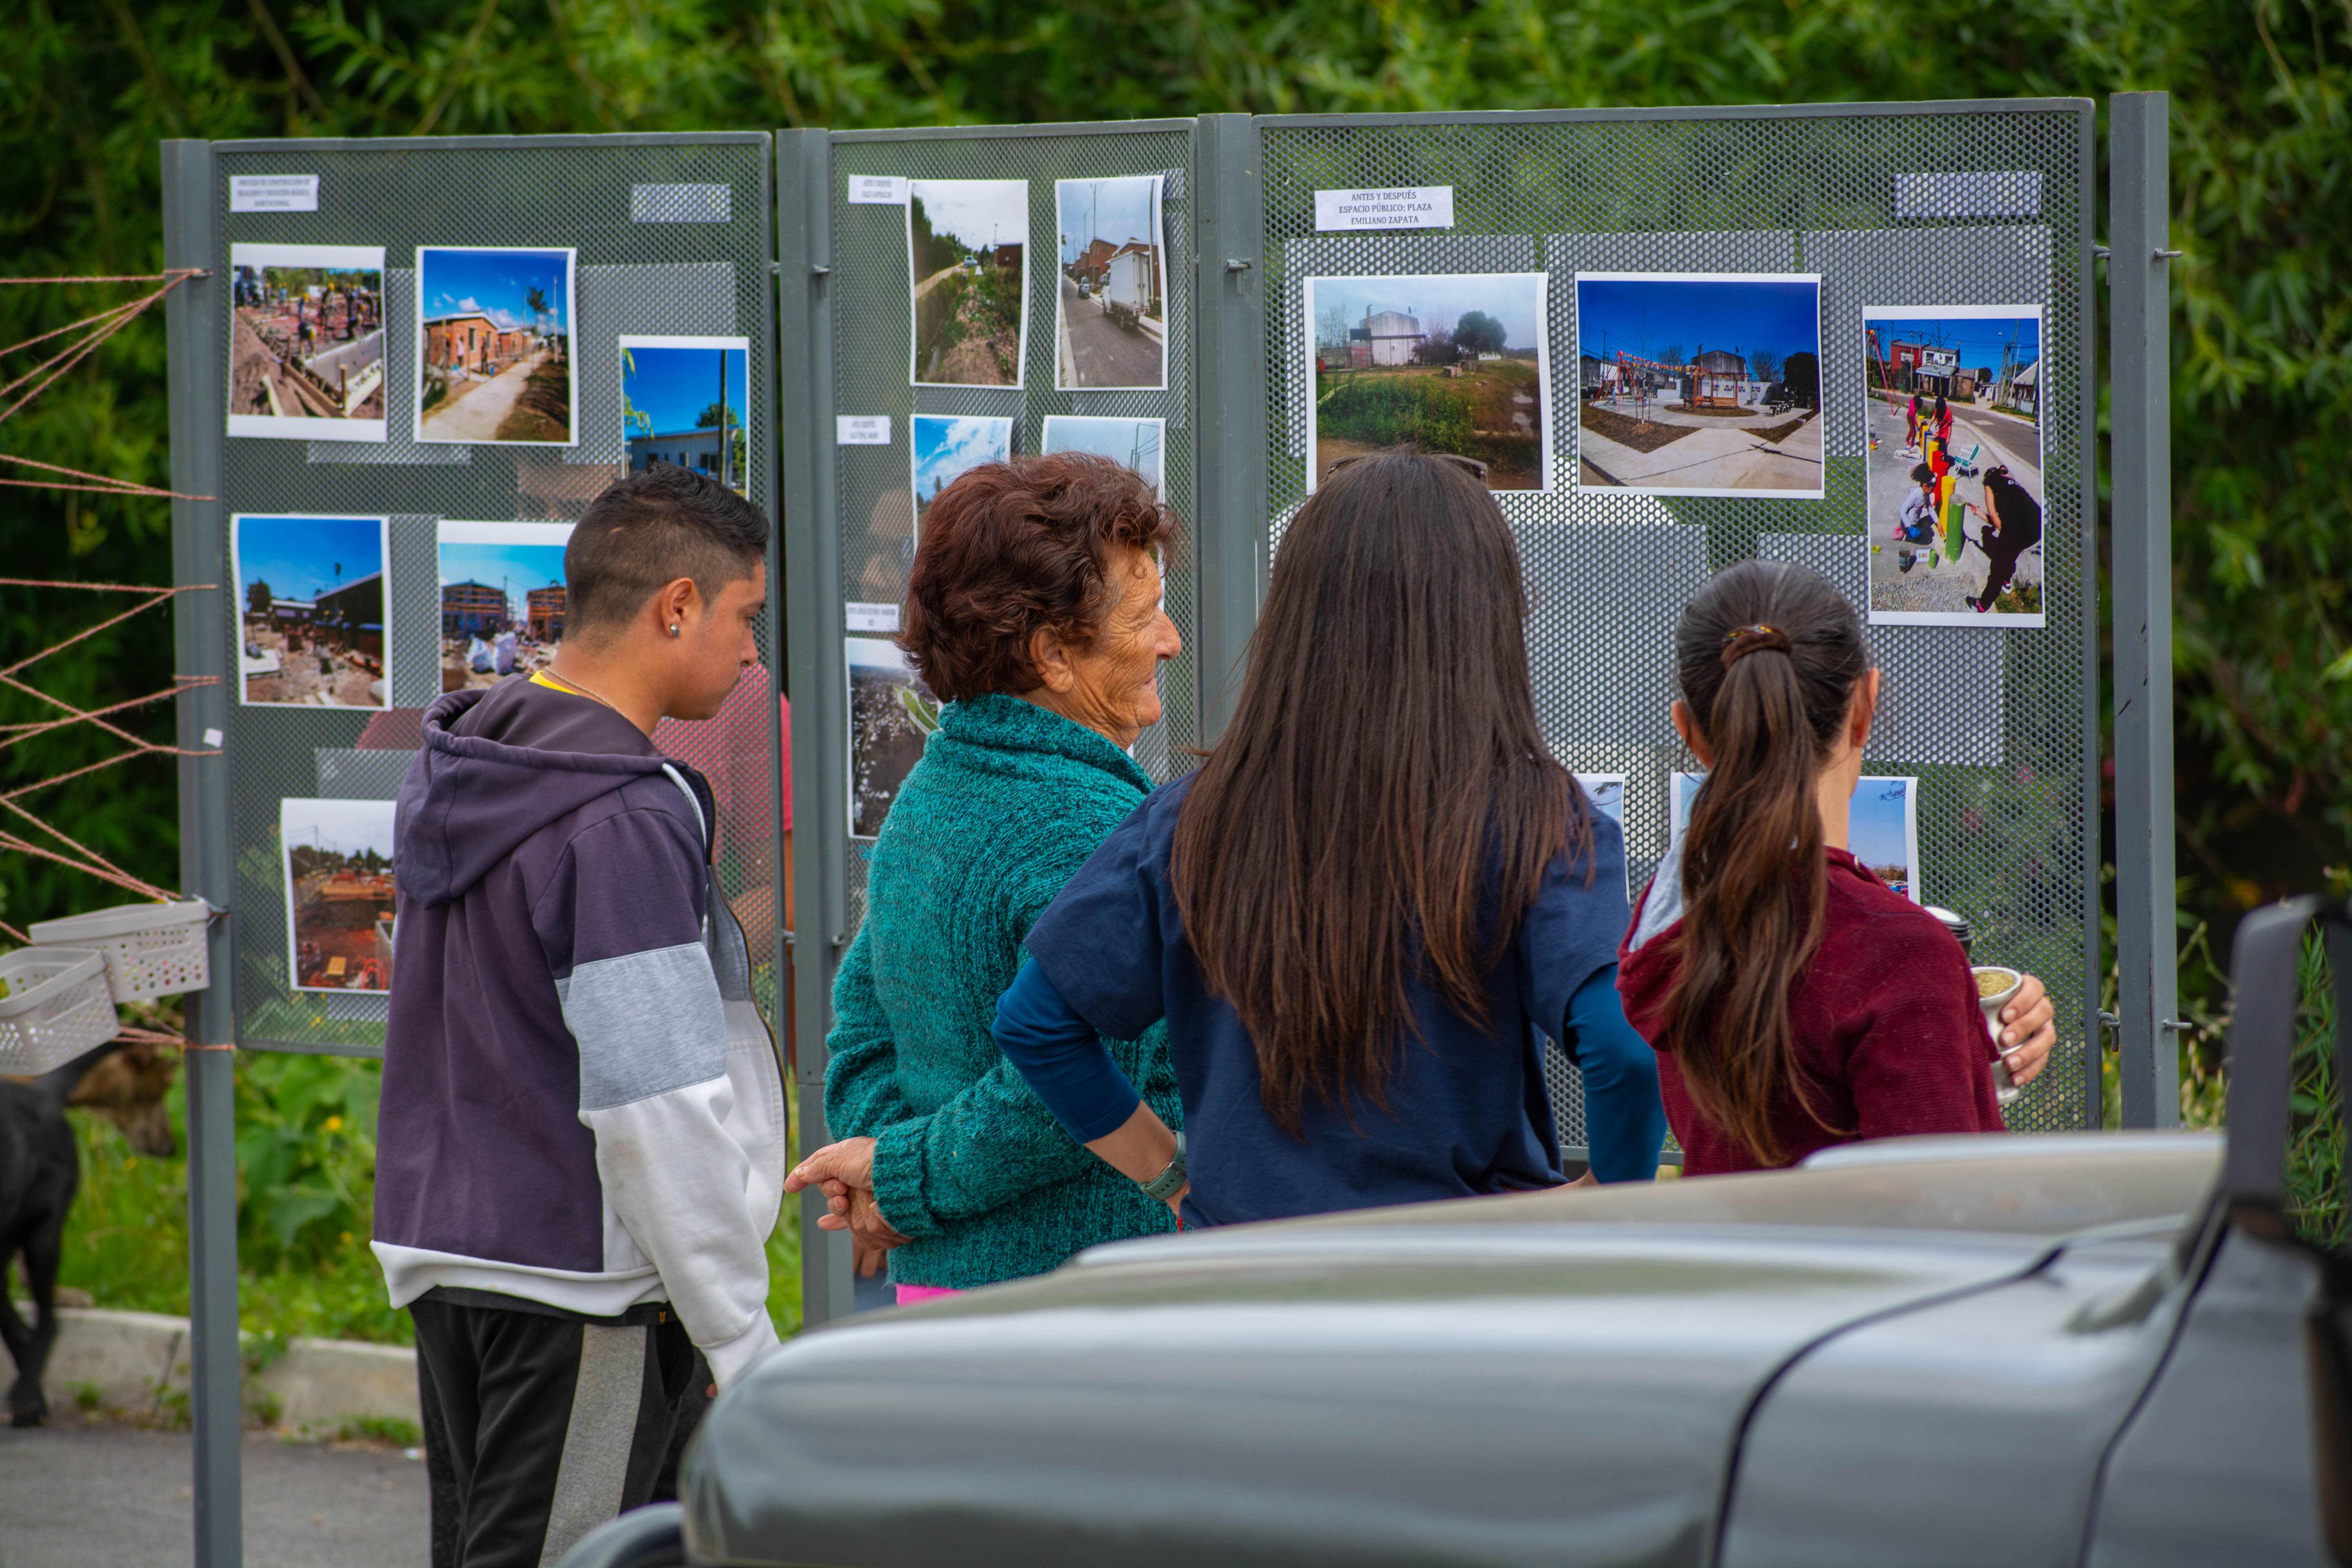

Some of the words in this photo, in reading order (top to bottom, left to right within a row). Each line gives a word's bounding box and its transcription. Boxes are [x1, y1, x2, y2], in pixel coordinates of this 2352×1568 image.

[1352, 193, 1375, 201] ANTES
[1383, 190, 1416, 200] DESPUÉS
[1339, 205, 1370, 214] ESPACIO
[1372, 202, 1405, 212] PÚBLICO:
[1407, 203, 1432, 211] PLAZA
[1351, 217, 1387, 225] EMILIANO
[1388, 216, 1419, 224] ZAPATA
